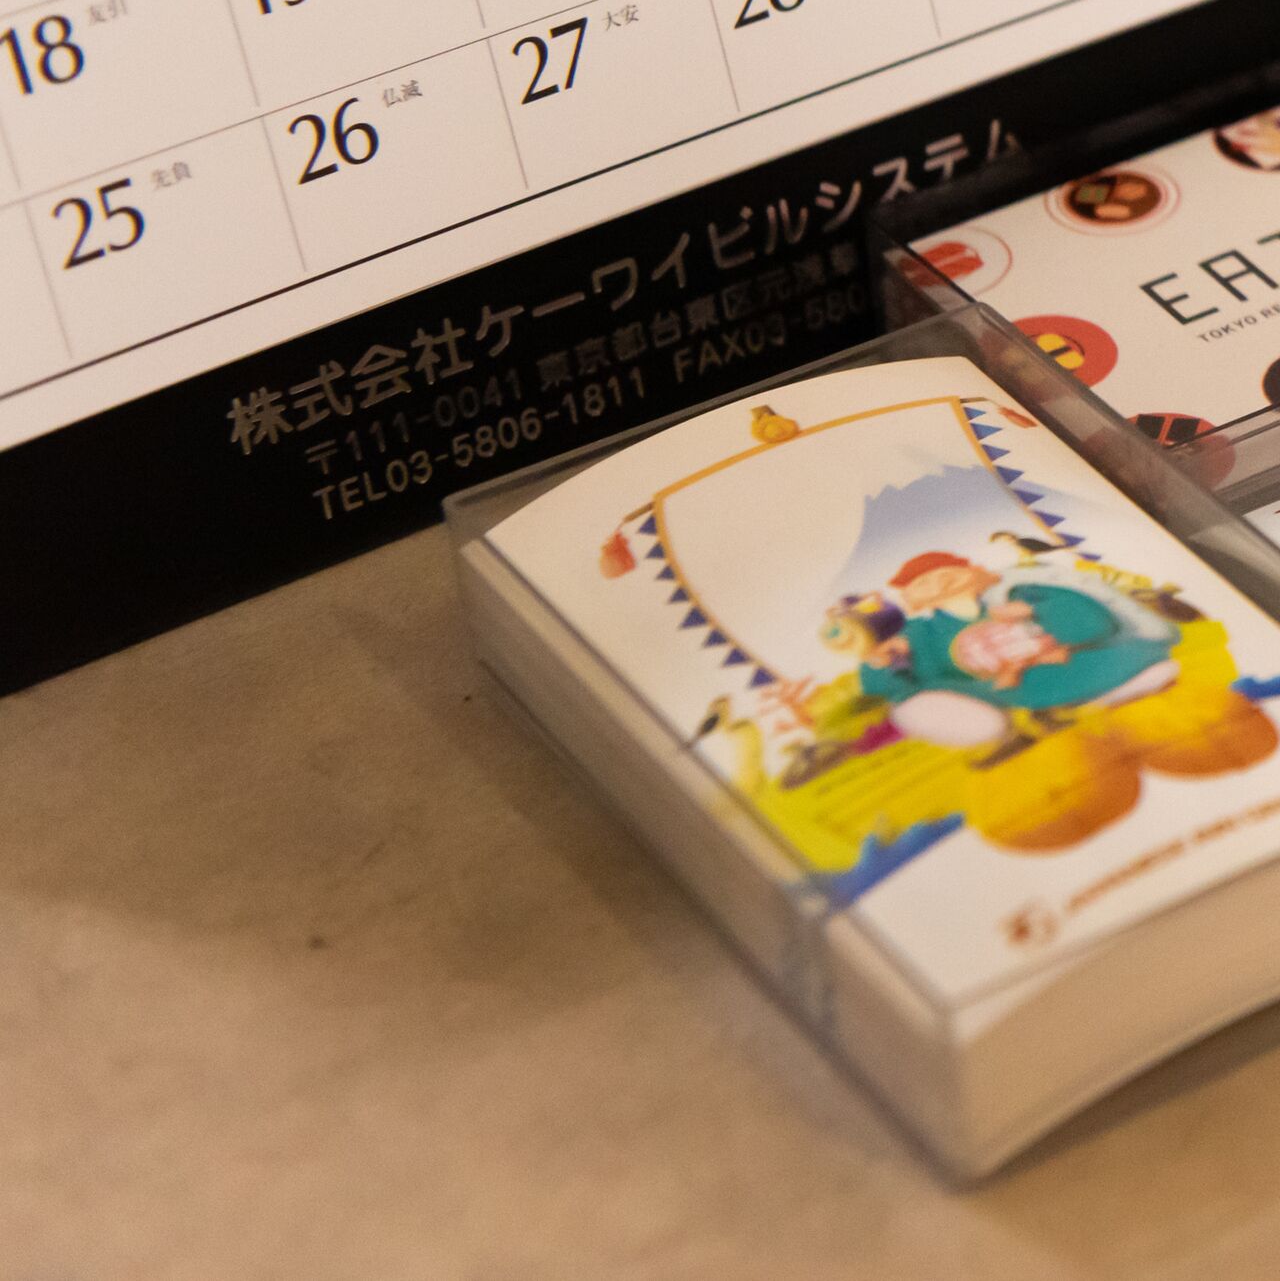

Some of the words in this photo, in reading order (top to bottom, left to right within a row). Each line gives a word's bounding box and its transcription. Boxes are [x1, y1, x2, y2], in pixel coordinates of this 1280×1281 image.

[0, 15, 85, 94] 18
[512, 17, 588, 104] 27
[288, 98, 379, 185] 26
[51, 178, 145, 270] 25
[1197, 315, 1258, 343] TOKYO
[313, 366, 645, 520] TEL03-5806-1811
